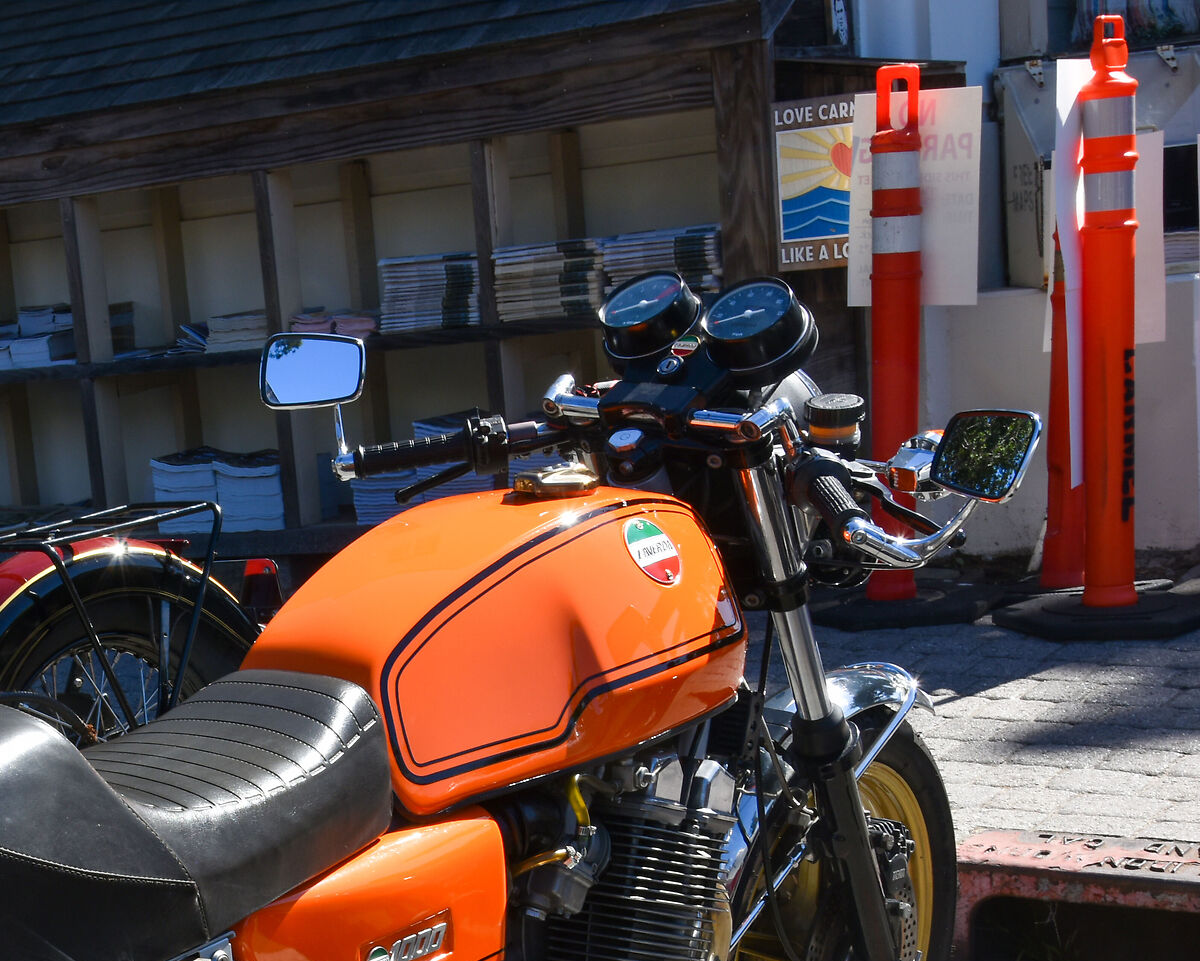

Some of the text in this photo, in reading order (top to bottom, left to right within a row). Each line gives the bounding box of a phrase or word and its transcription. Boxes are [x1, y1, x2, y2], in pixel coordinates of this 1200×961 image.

[774, 106, 813, 126] LOVE
[782, 246, 814, 264] LIKE
[819, 244, 829, 261] A
[1143, 843, 1200, 859] ND
